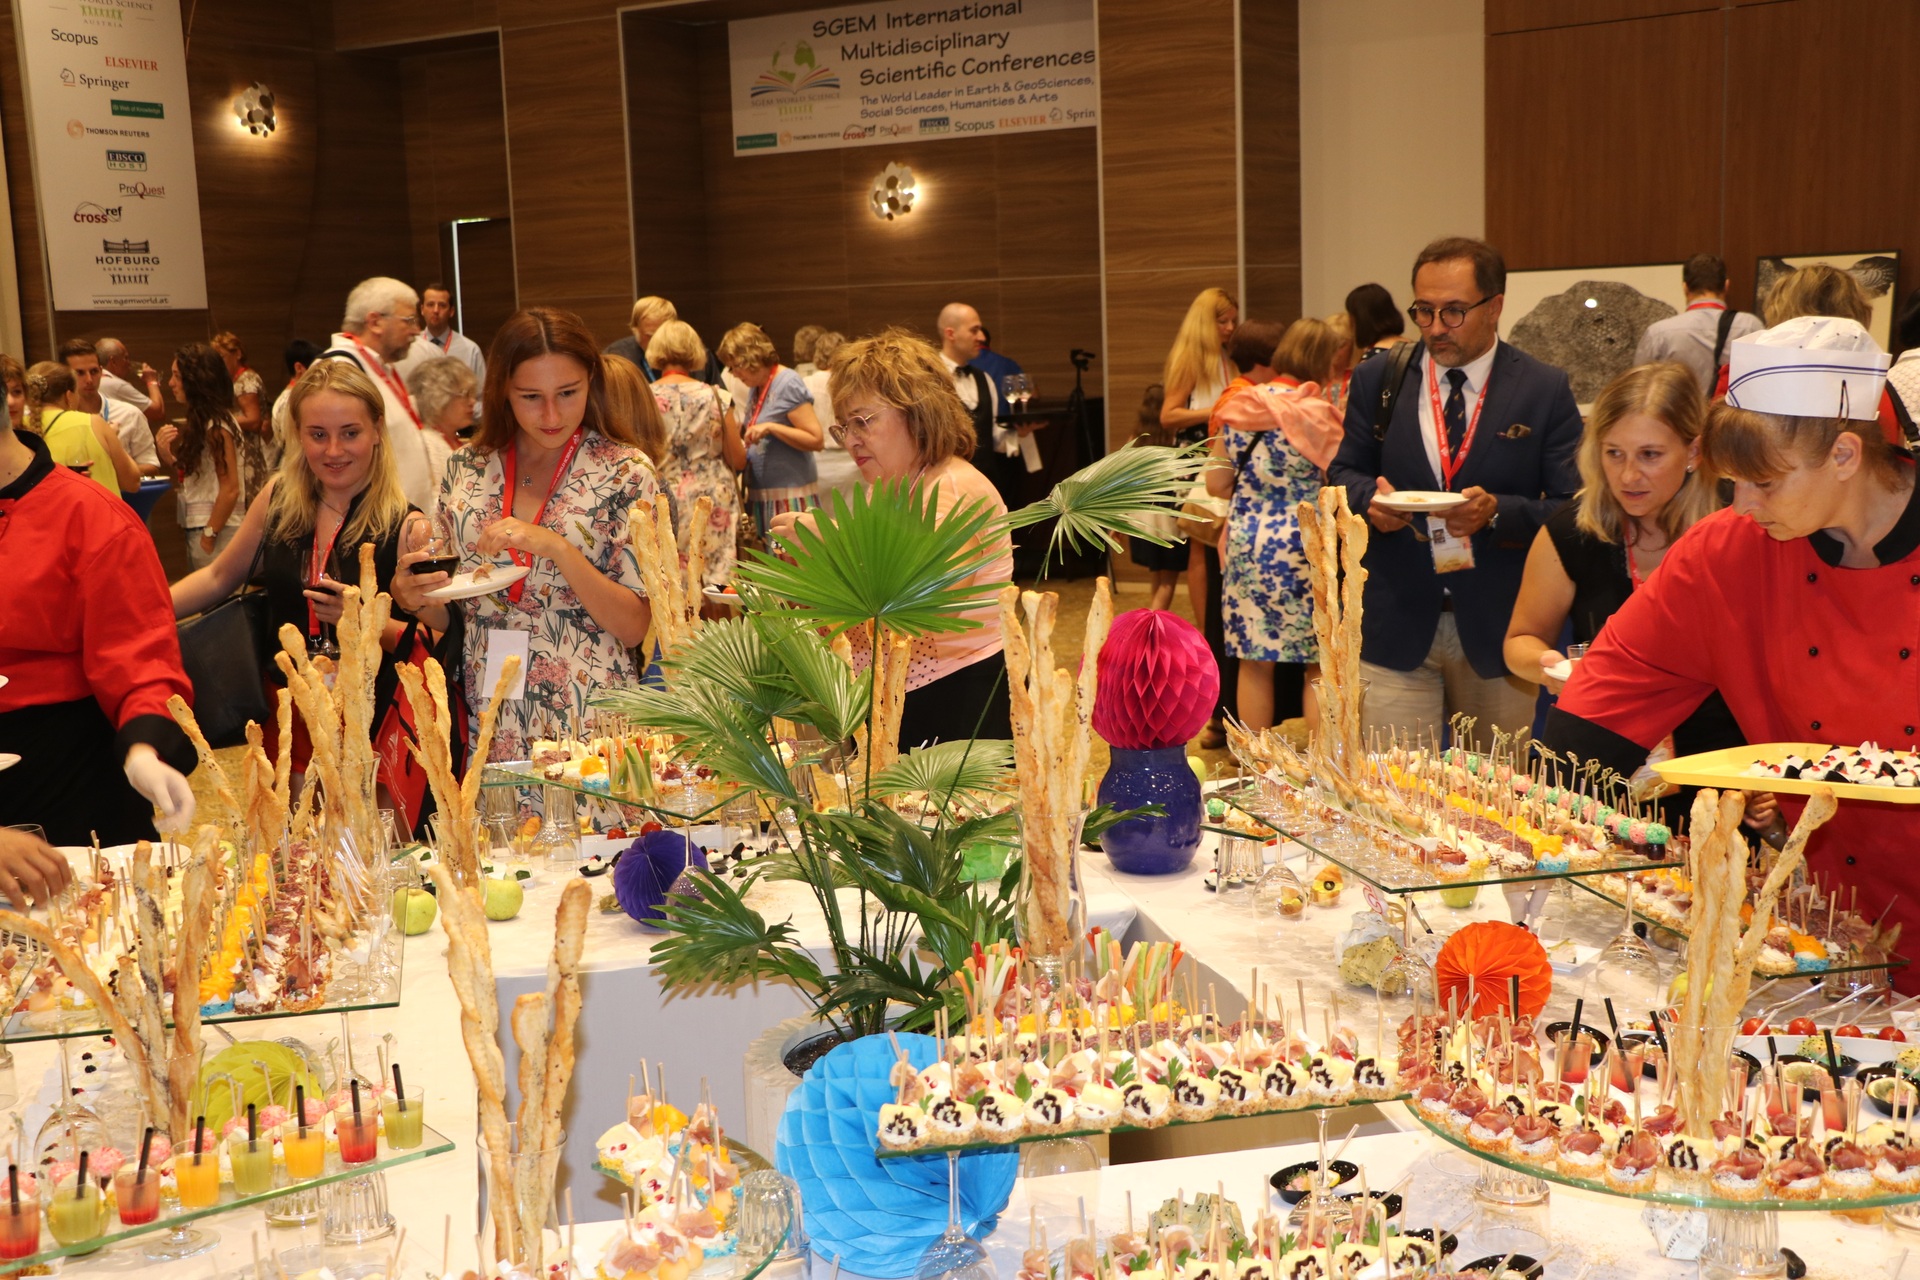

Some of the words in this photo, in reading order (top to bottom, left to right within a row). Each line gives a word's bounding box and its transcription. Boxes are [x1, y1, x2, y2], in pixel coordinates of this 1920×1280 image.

[83, 19, 123, 28] AUSTRIA
[813, 15, 876, 38] SGEM
[887, 0, 1022, 29] International
[51, 28, 98, 46] Scopus
[841, 31, 1010, 61] Multidisciplinary
[105, 56, 159, 71] ELSEVIER
[860, 61, 956, 86] Scientific
[962, 50, 1096, 76] Conferences
[79, 73, 130, 91] Springer
[860, 95, 878, 106] The
[881, 92, 912, 104] World
[914, 89, 952, 101] Leader
[955, 87, 964, 97] in
[966, 83, 1000, 96] Earth
[1002, 82, 1012, 93] &
[1014, 76, 1095, 92] GeoSciences,
[860, 107, 893, 119] Social
[895, 103, 948, 116] Sciences,
[950, 97, 1015, 111] Humanities
[1018, 94, 1027, 105] &
[1029, 93, 1058, 104] Arts
[955, 120, 995, 133] Scopus
[998, 115, 1047, 128] ELSEVIER
[86, 127, 119, 136] THOMSON
[119, 129, 150, 138] REUTERS
[109, 152, 144, 162] EBSCO
[109, 161, 143, 169] HOST
[119, 182, 165, 200] ProQuest
[95, 256, 160, 265] HOFBURG
[92, 297, 169, 306] www.sgemworld.at
